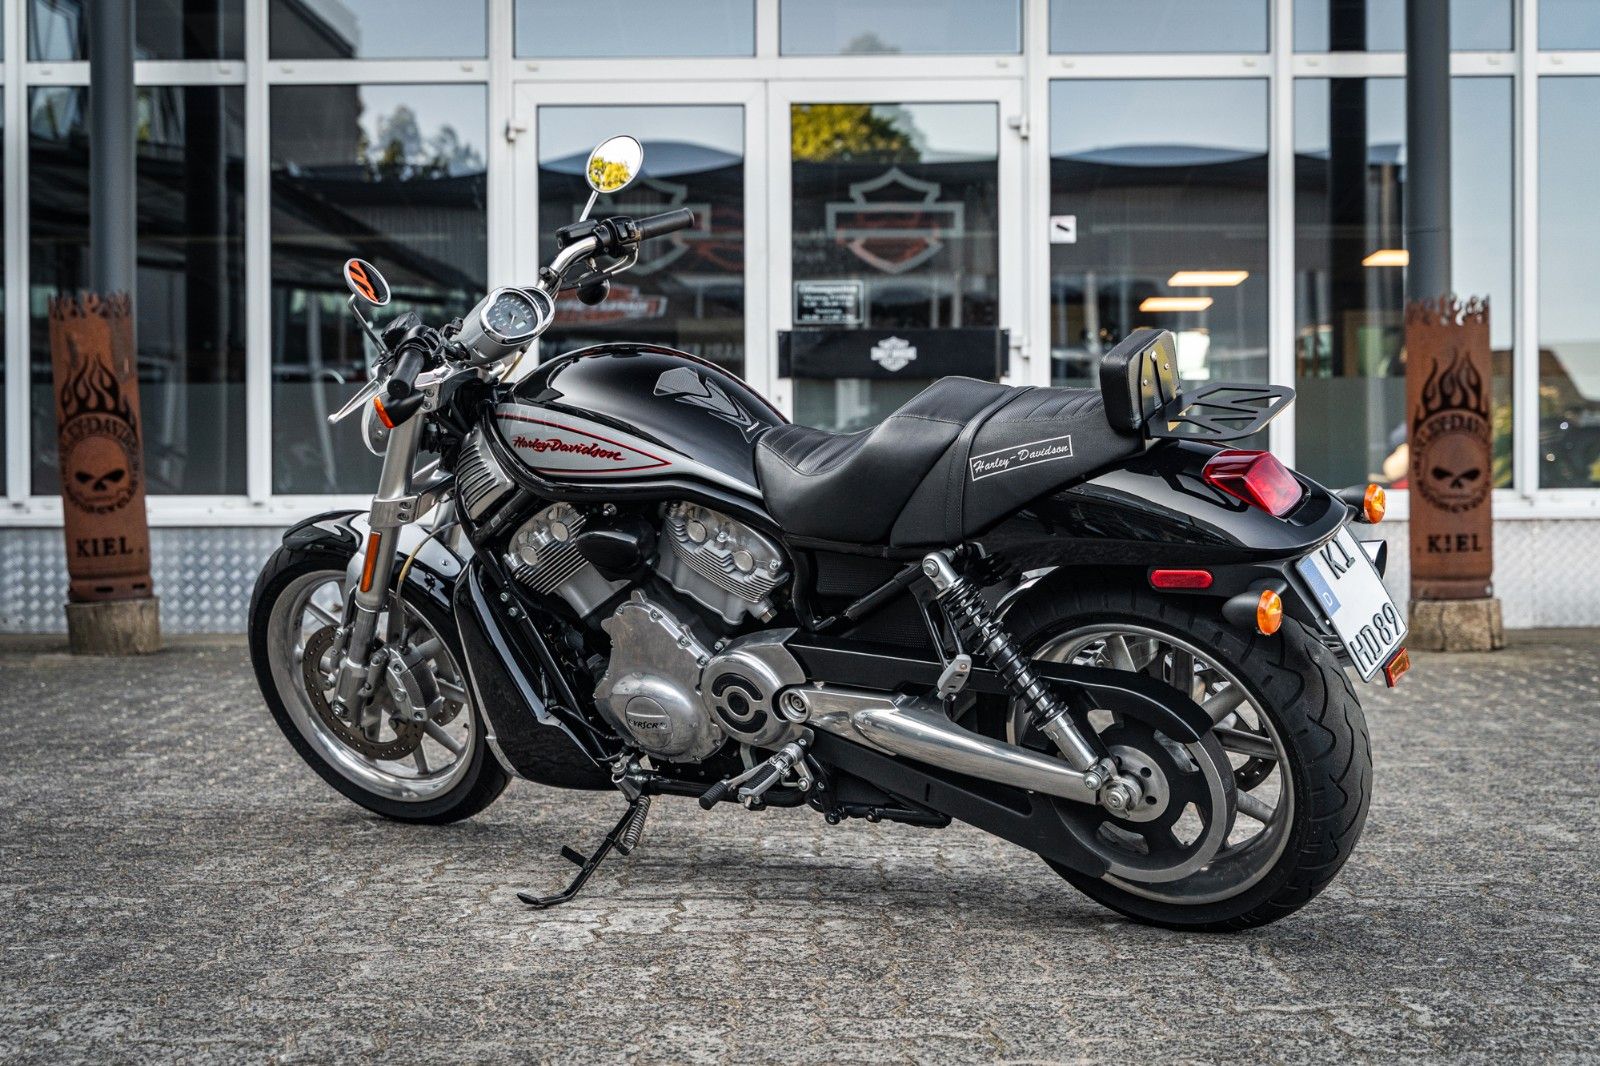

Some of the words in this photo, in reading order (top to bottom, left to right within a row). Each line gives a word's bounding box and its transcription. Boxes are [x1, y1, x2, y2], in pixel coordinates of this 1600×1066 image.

[75, 535, 134, 558] KIEL
[1427, 532, 1483, 554] KIEL
[1319, 537, 1356, 580] KI
[1321, 591, 1334, 608] D
